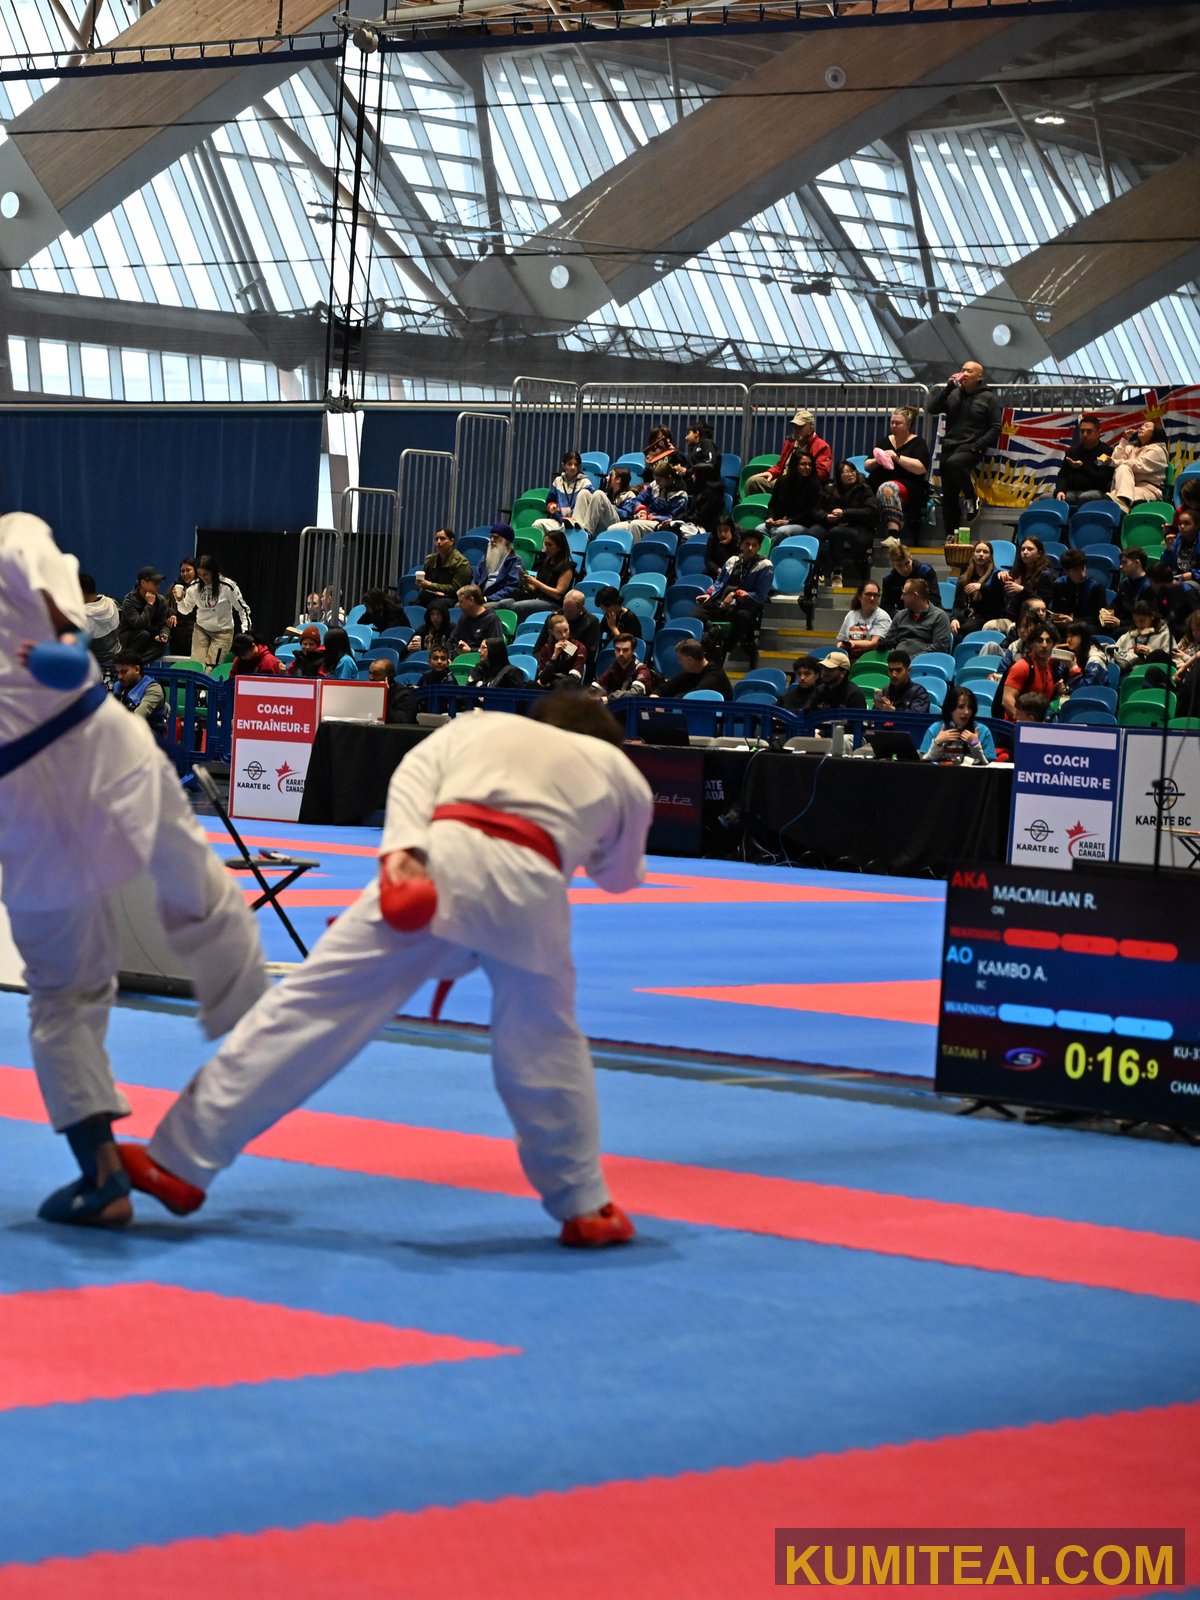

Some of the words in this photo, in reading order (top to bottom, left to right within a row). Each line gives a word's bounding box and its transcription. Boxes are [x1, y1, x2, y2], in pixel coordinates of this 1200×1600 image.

[257, 703, 293, 715] COACH
[1043, 753, 1090, 769] COACH
[237, 782, 261, 790] KARATE
[286, 785, 304, 793] CANAD
[1177, 817, 1192, 827] BC
[1016, 843, 1047, 853] KARATE
[1048, 846, 1059, 854] BC
[1078, 841, 1106, 850] KARATE
[1078, 849, 1106, 858] CANADA
[951, 870, 989, 889] AKA
[992, 885, 1081, 908] MACMILLAN
[1083, 893, 1098, 910] R.
[946, 945, 974, 965] AO
[977, 959, 1031, 980] KAMBO
[1032, 966, 1048, 982] A.
[943, 1000, 998, 1019] WARNING
